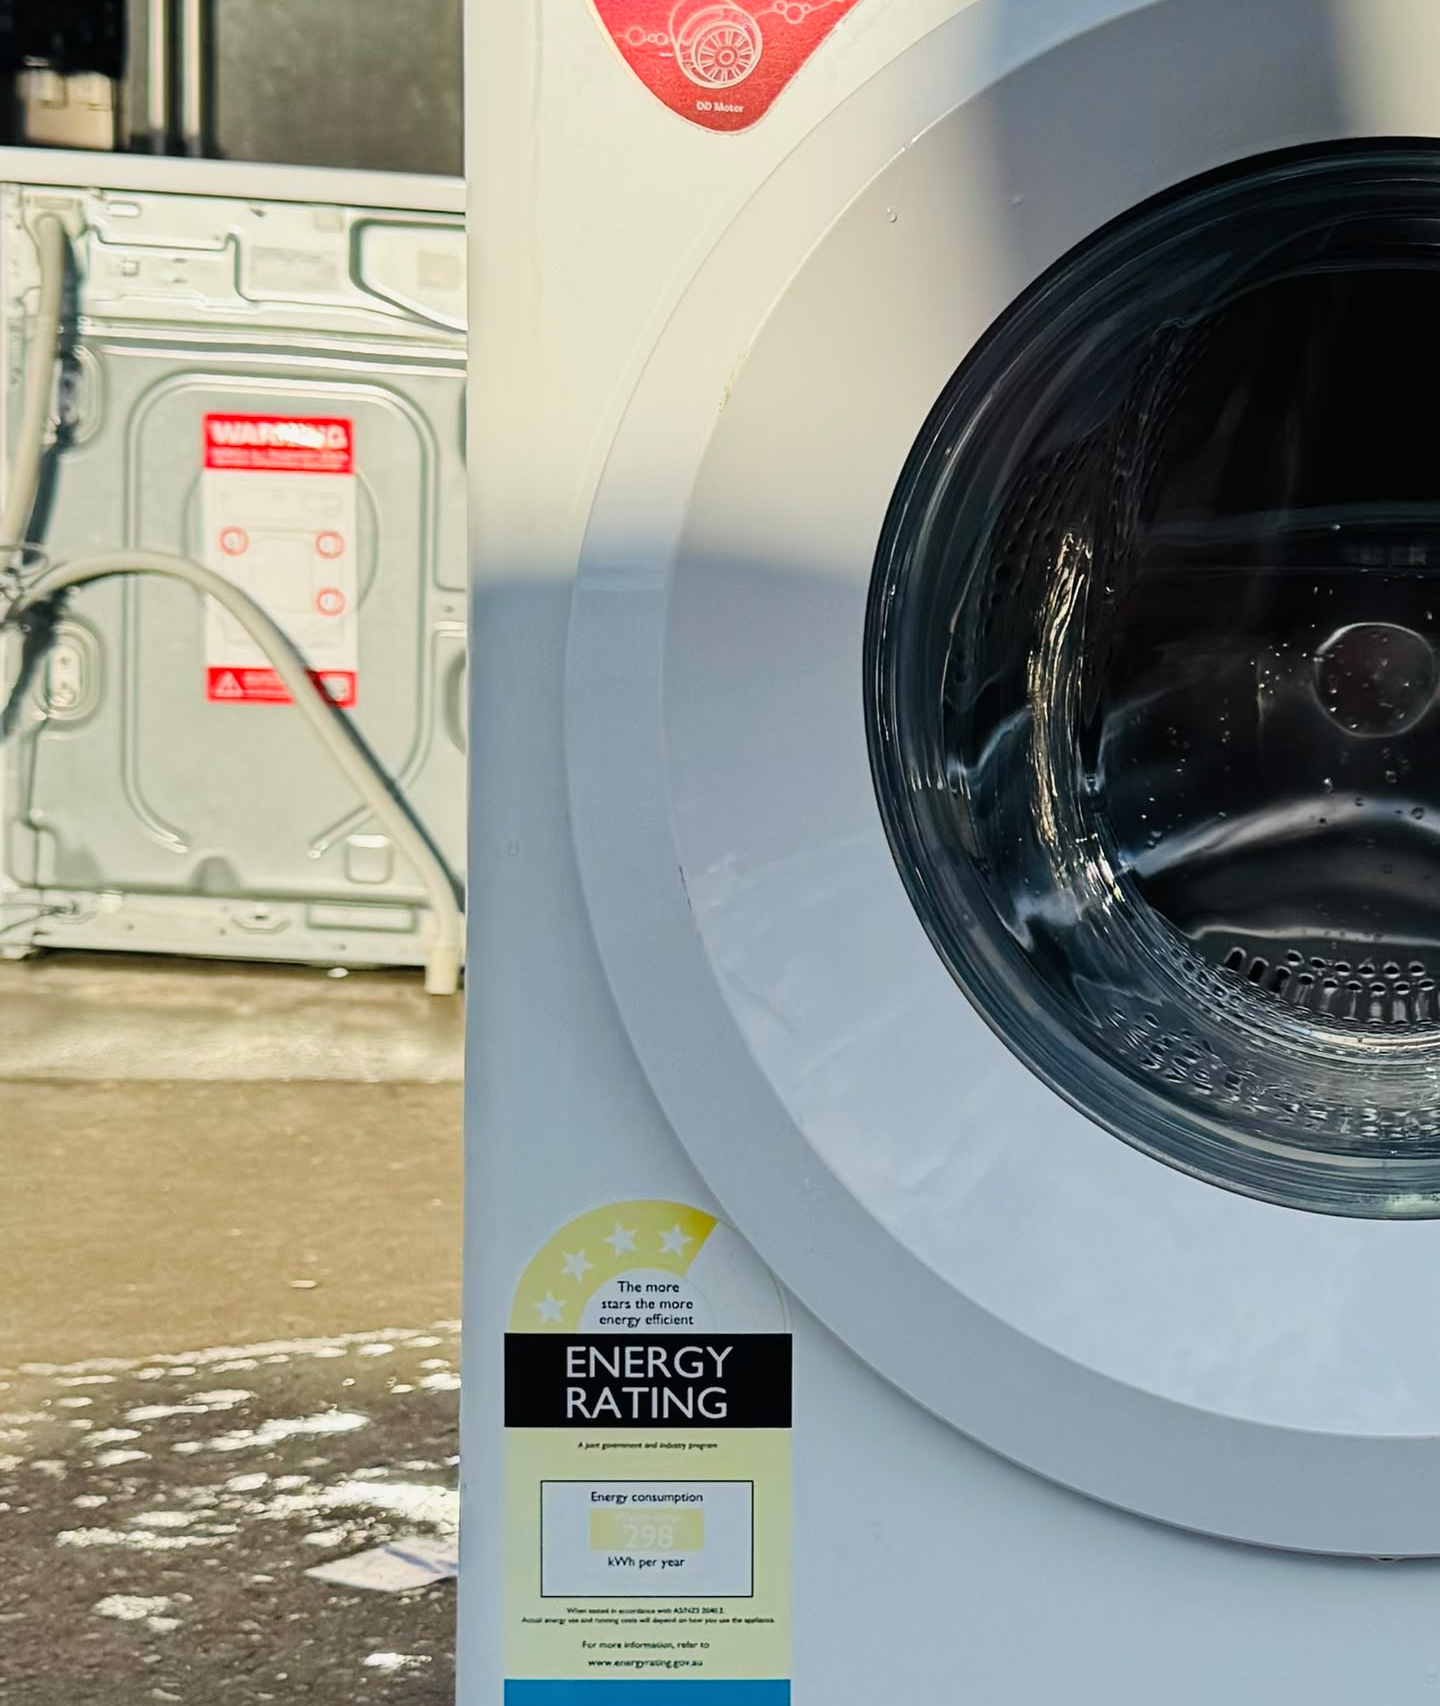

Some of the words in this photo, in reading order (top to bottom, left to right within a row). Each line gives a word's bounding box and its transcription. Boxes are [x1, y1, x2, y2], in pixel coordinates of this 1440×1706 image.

[617, 1280, 642, 1293] The
[646, 1283, 680, 1293] more
[601, 1299, 632, 1310] stars
[635, 1298, 656, 1310] the
[660, 1300, 694, 1310] more
[599, 1315, 642, 1329] energy
[645, 1313, 694, 1326] efficient
[566, 1346, 734, 1379] ENERGY
[566, 1387, 728, 1419] RATING
[591, 1491, 628, 1505] Energy
[632, 1492, 704, 1505] consumption
[608, 1556, 636, 1567] kWh
[638, 1559, 657, 1569] per
[660, 1559, 686, 1569] year
[582, 1640, 596, 1649] For
[624, 1641, 675, 1649] information,
[677, 1641, 698, 1649] refer
[700, 1641, 710, 1649] to
[588, 1659, 703, 1669] www.energyrating.gov.au
